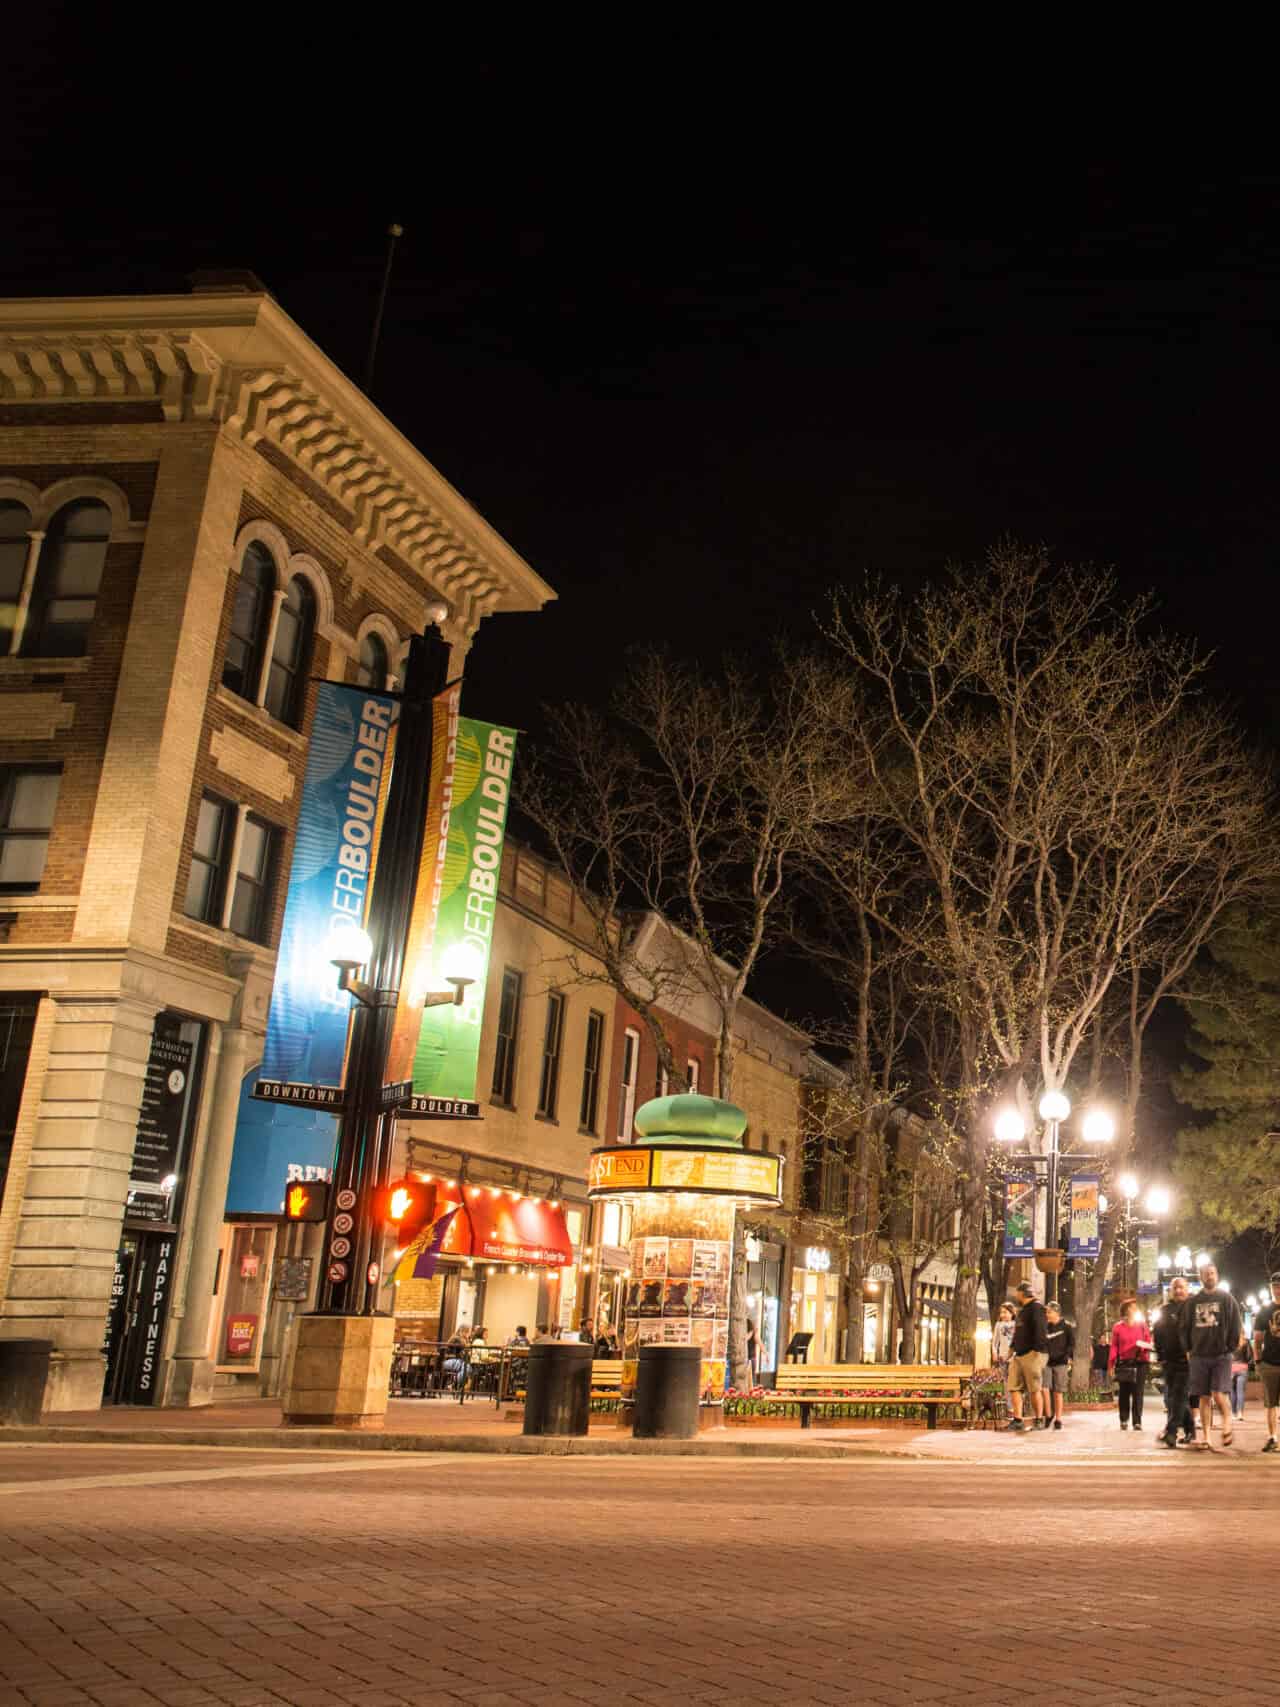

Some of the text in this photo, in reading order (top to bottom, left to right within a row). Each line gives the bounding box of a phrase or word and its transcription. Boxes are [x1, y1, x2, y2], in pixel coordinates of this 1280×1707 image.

[320, 700, 392, 1011] BDERBOULDER
[453, 729, 515, 1024] BDERBOULDER
[263, 1084, 335, 1101] DOWNTOWN
[411, 1099, 468, 1114] BOULDER
[616, 1159, 645, 1173] END
[140, 1242, 171, 1390] HAPPINESS
